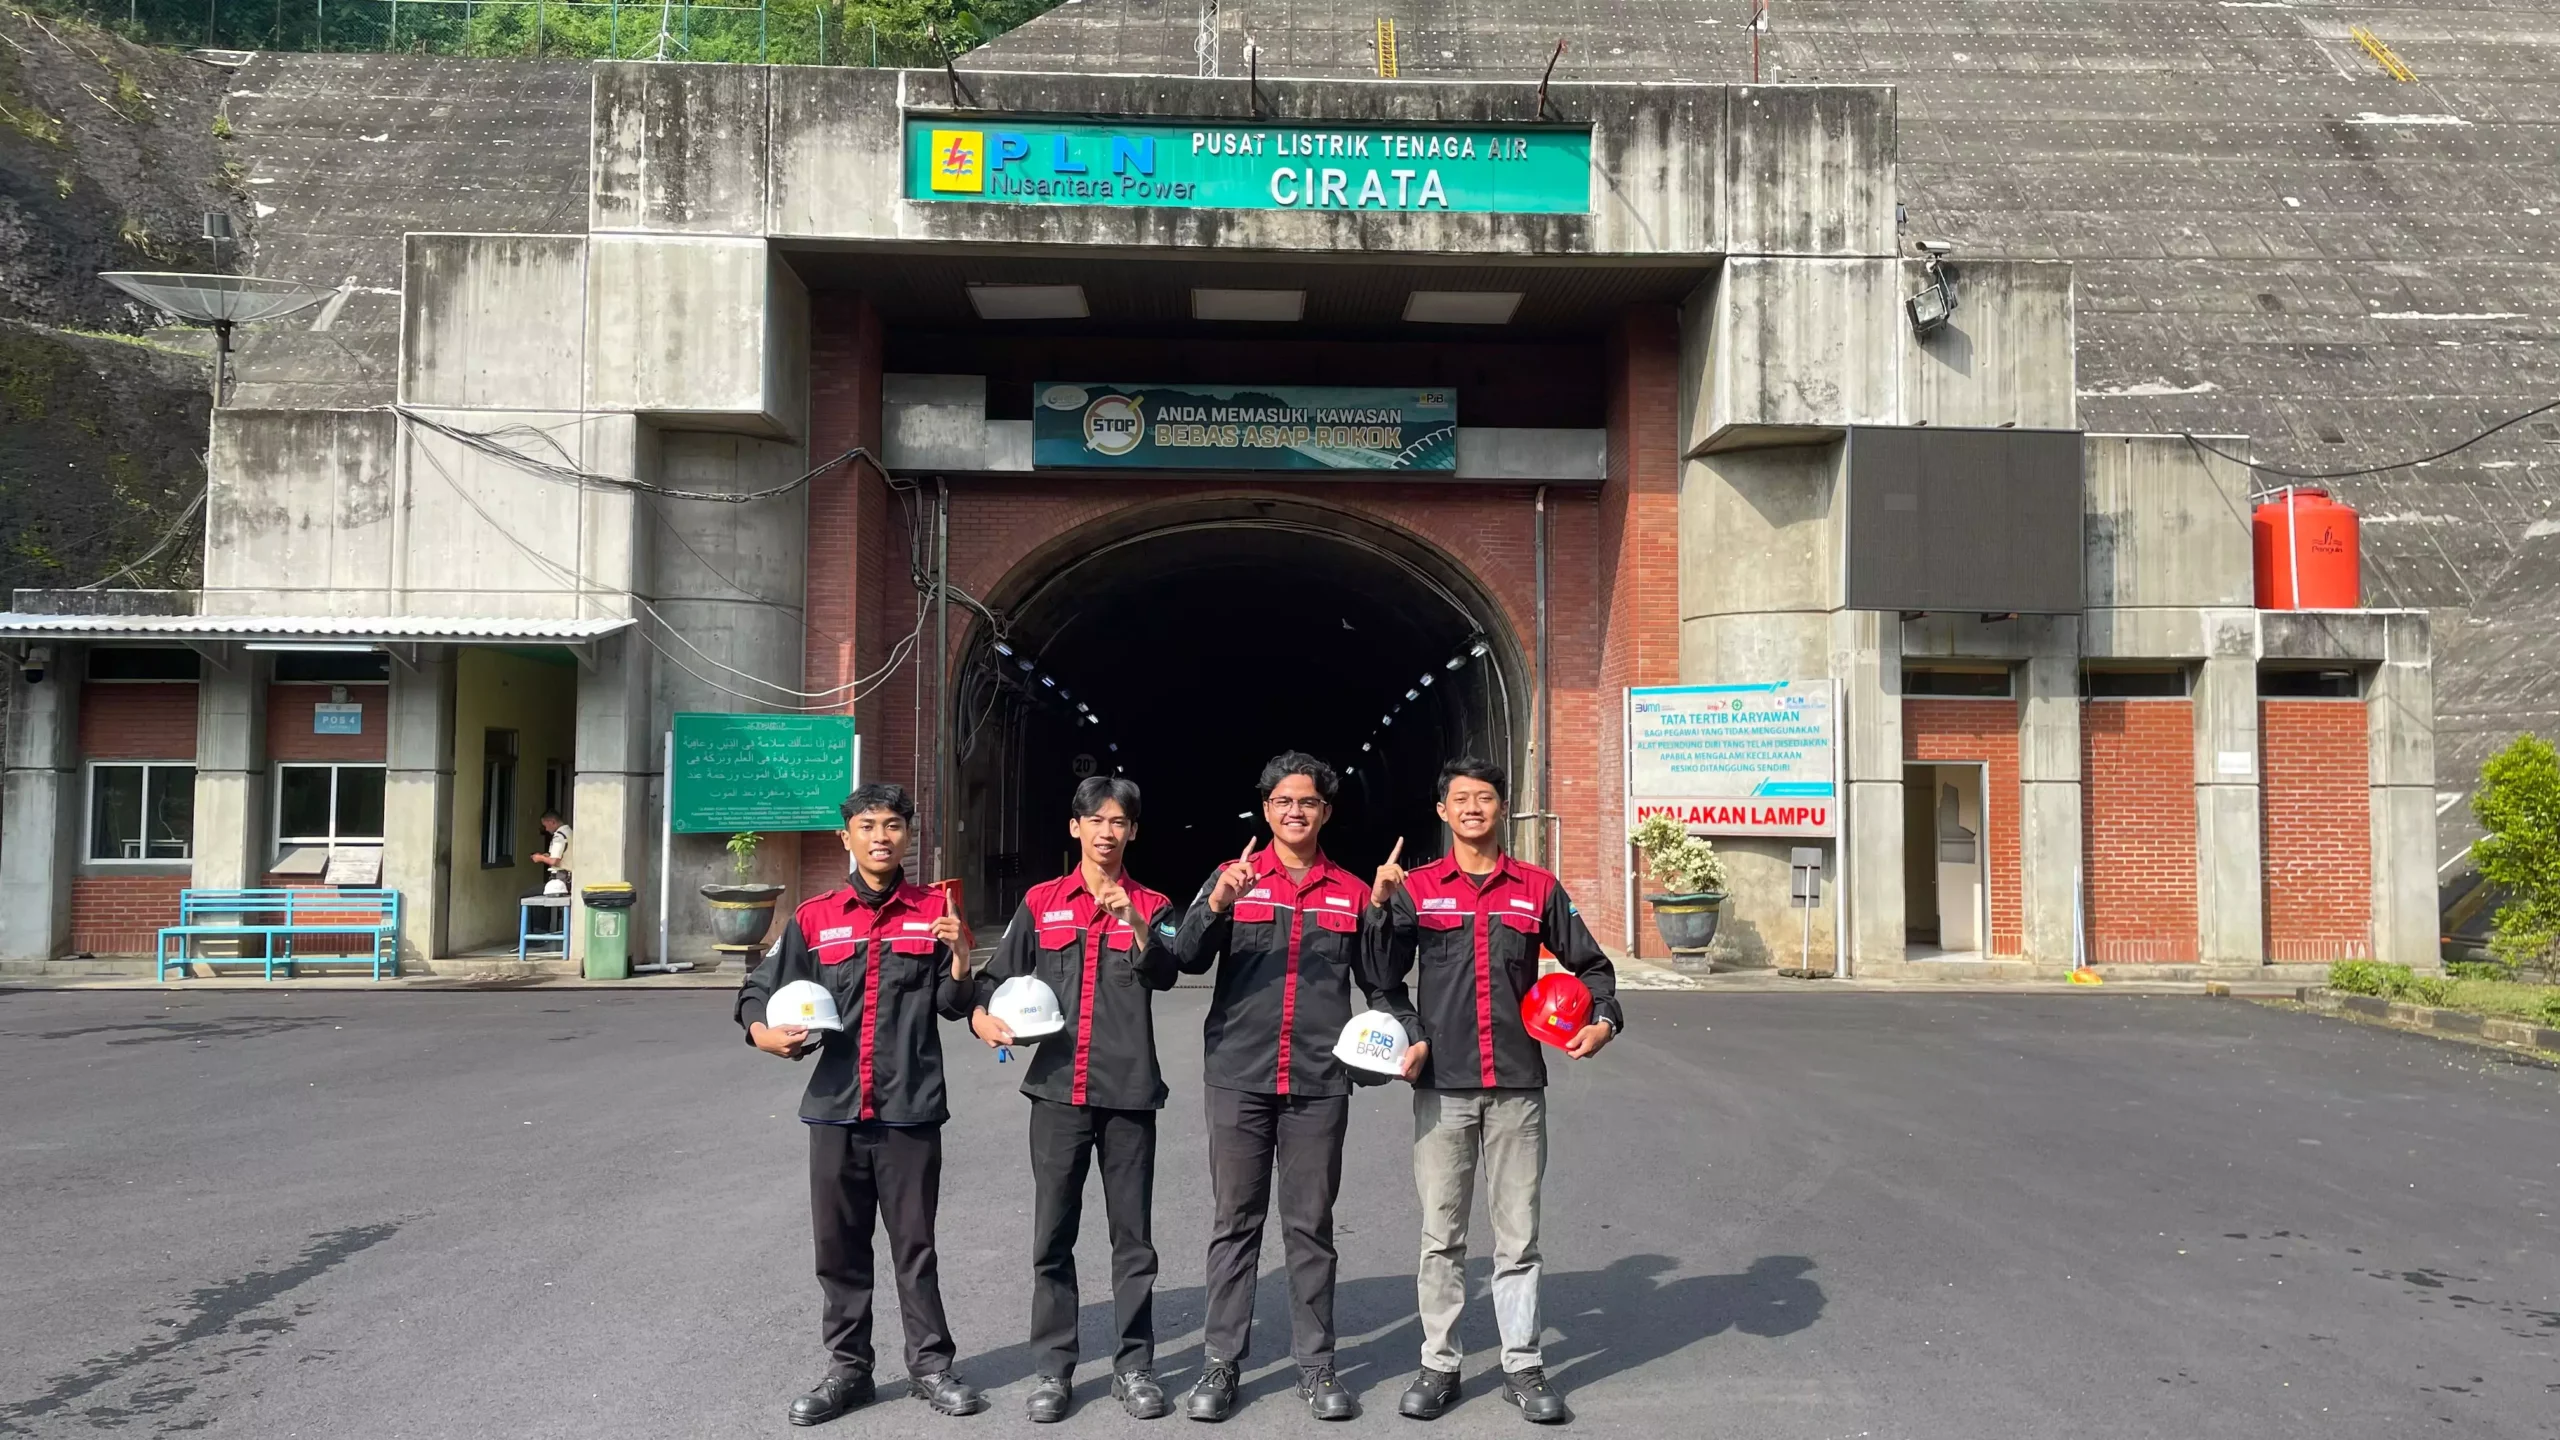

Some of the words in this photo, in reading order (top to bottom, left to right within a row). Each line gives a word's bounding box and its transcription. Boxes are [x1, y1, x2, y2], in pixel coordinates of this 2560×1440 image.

[1192, 132, 1265, 155] PUSAT
[1277, 134, 1369, 157] LISTRIK
[1381, 136, 1476, 159] TENAGA
[1488, 138, 1528, 159] AIR
[991, 133, 1155, 175] PLN
[991, 172, 1112, 197] Nusantara
[1121, 175, 1196, 200] Power
[1270, 167, 1449, 208] CIRATA
[1157, 406, 1207, 422] ANDA
[1211, 407, 1307, 423] MEMASUKI
[1316, 408, 1402, 424] KAWASAN
[1093, 418, 1135, 432] STOP
[1155, 424, 1239, 447] BEBAS
[1242, 425, 1309, 448] ASAP
[1315, 426, 1402, 449] ROKOK
[322, 715, 345, 725] POS
[349, 715, 355, 725] 4
[1661, 714, 1687, 725] TATA
[1689, 712, 1728, 724] TERTIB
[1732, 711, 1799, 723] KARYAWAN
[1644, 729, 1662, 737] BAGI
[1664, 728, 1699, 737] PEGAWAI
[1701, 727, 1723, 736] YANG
[1725, 727, 1749, 735] TIDAK
[1751, 725, 1820, 735] MENGGUNAKAN
[1637, 741, 1656, 750] ALAT
[1704, 740, 1721, 749] DIRI
[1723, 740, 1745, 748] YANG
[1775, 738, 1828, 748] DISEDIAKAN
[1660, 753, 1692, 761] APABILA
[1694, 752, 1744, 760] MENGALAMI
[1746, 751, 1802, 760] KECELAKAAN
[1075, 758, 1090, 773] 20
[1671, 764, 1698, 773] RESIKO
[1700, 763, 1755, 772] DITANGGUNG
[1757, 763, 1790, 772] SENDIRI
[1751, 806, 1826, 826] LAMPU
[1356, 1041, 1392, 1061] BPWC
